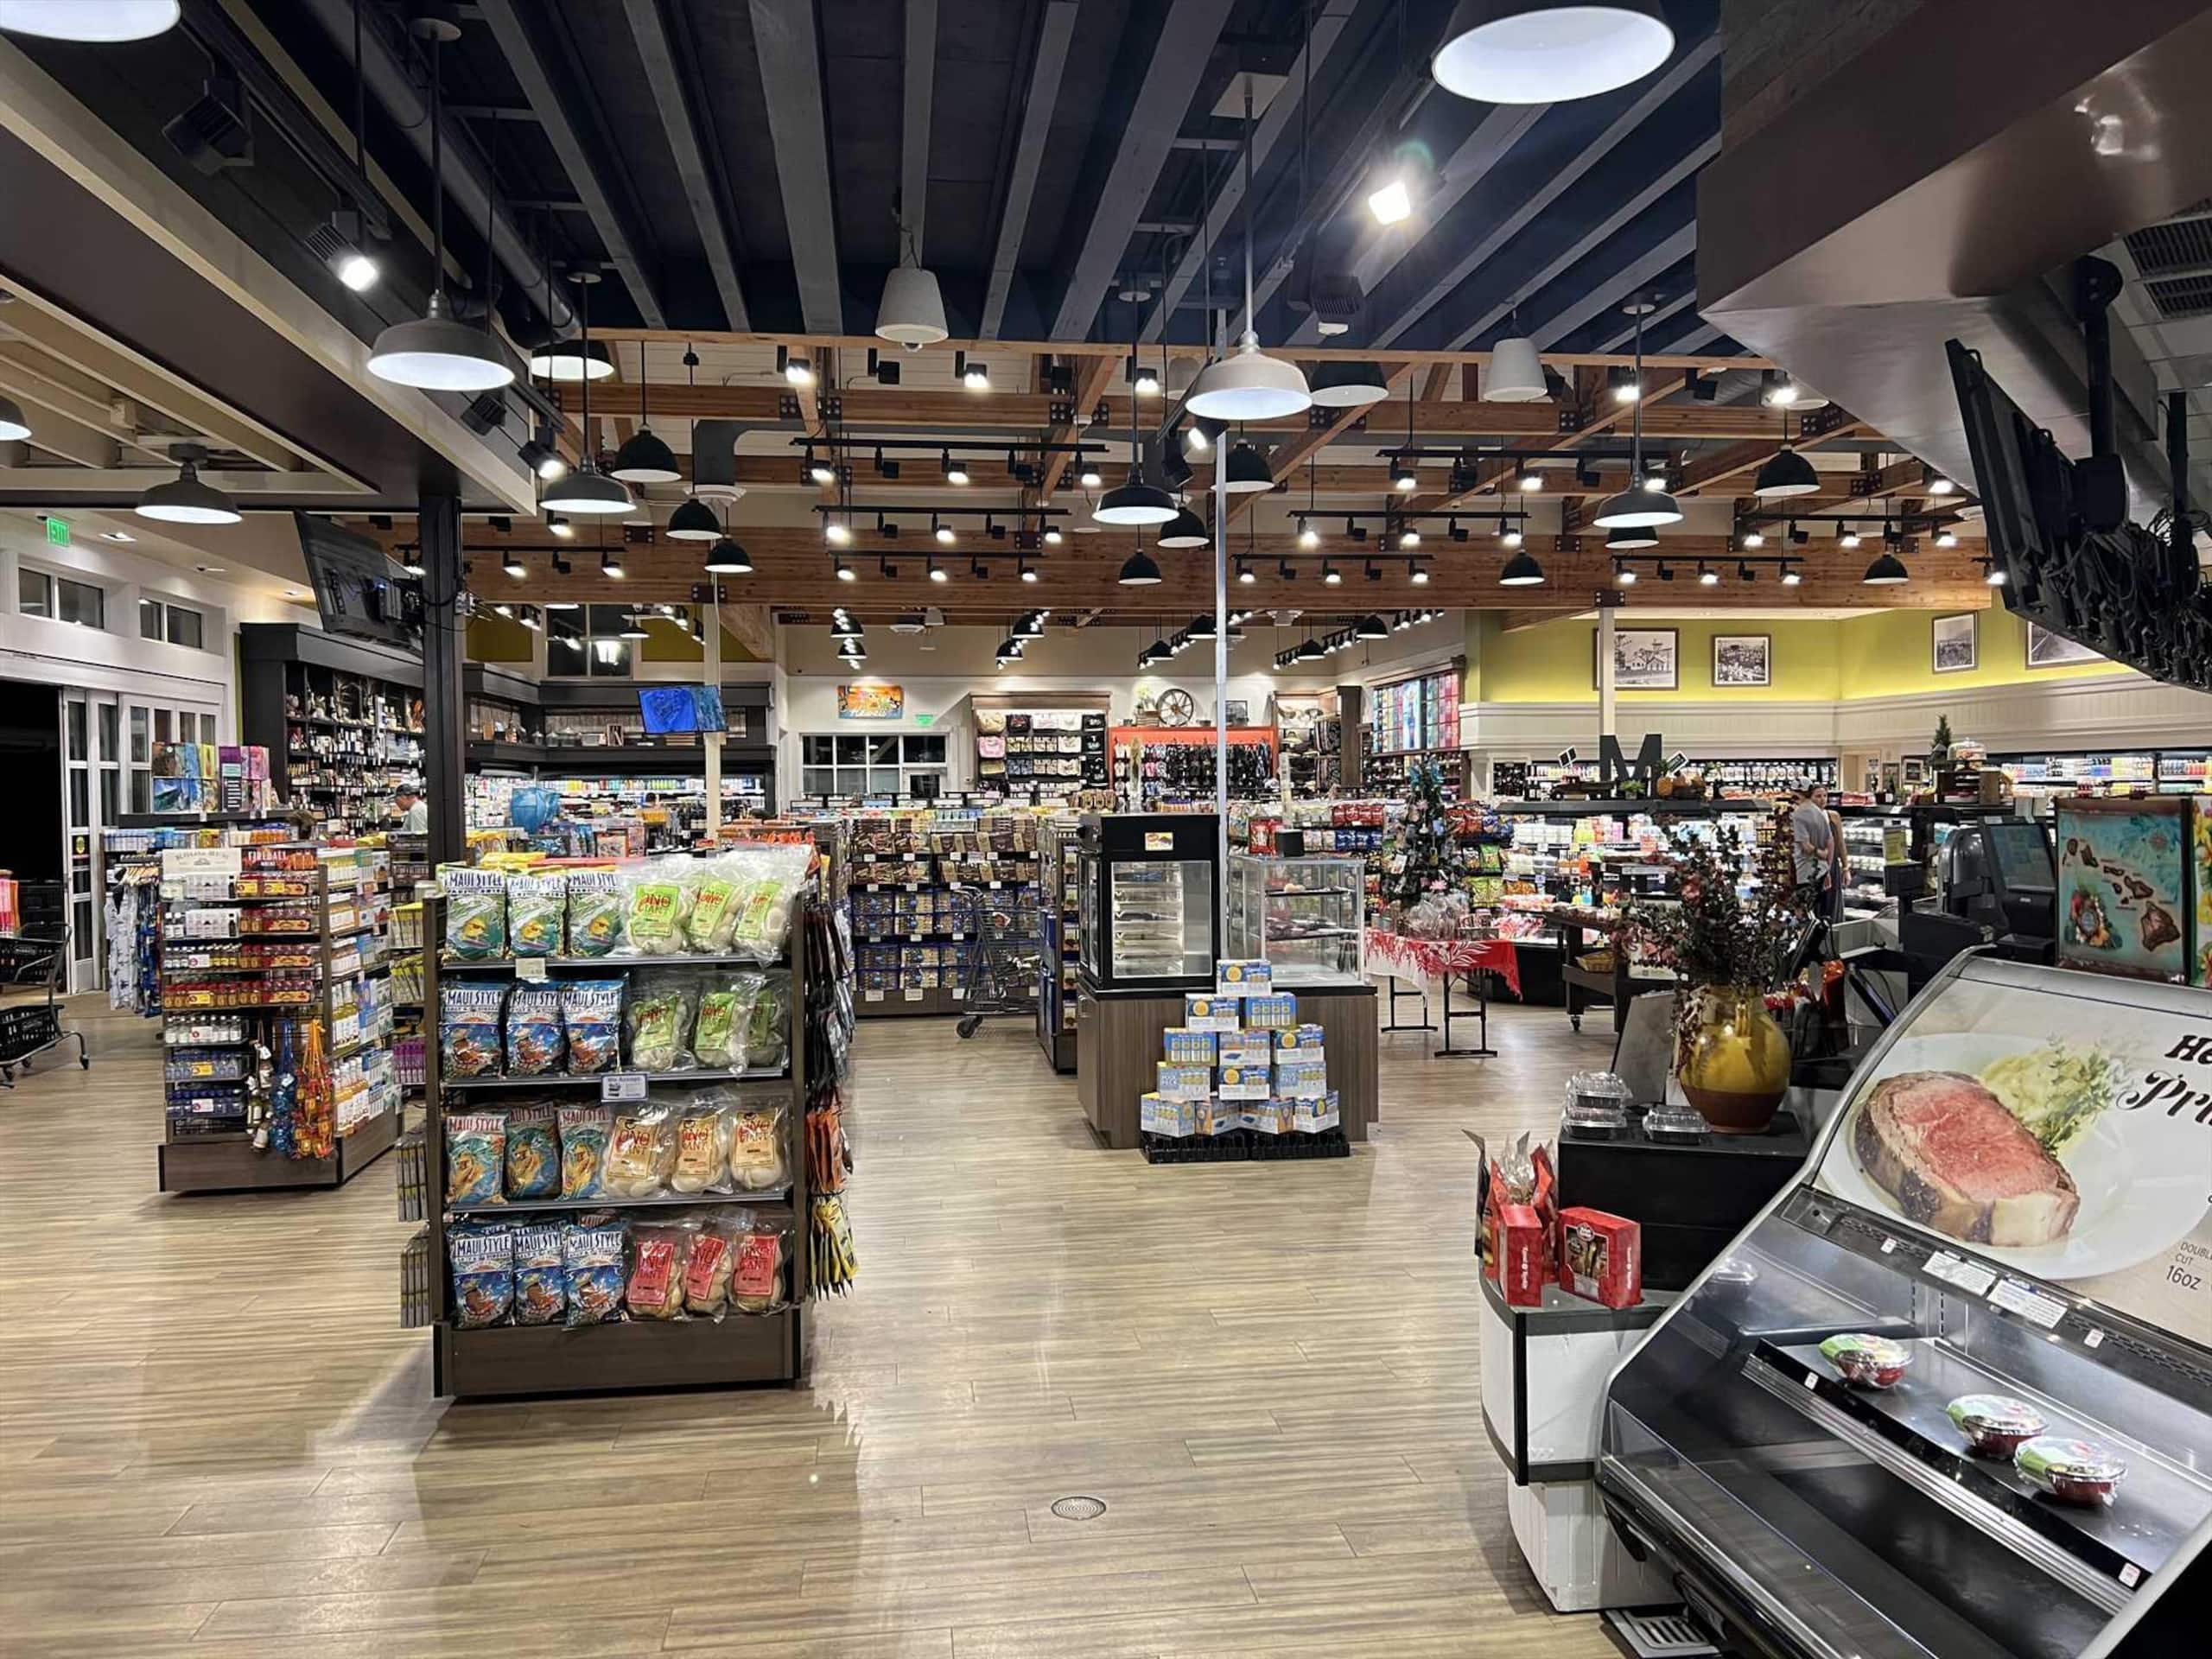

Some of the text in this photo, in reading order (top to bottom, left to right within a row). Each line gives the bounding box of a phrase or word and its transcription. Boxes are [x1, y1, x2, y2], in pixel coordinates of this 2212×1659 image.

[449, 872, 502, 887] MAUI STYLE
[573, 873, 617, 887] MAUI STYL
[448, 990, 473, 1005] MAUI
[512, 991, 538, 1007] MAUI
[563, 991, 617, 1007] MAUI STYLE
[510, 1105, 552, 1121] AUI STYLE
[563, 1109, 586, 1124] MAUI
[448, 1117, 500, 1131] MAUI STYLE
[457, 1236, 510, 1255] MAUI STYLE
[515, 1236, 539, 1253] MAUI
[569, 1232, 621, 1251] MAUI STYLE
[2176, 1253, 2193, 1265] CUT
